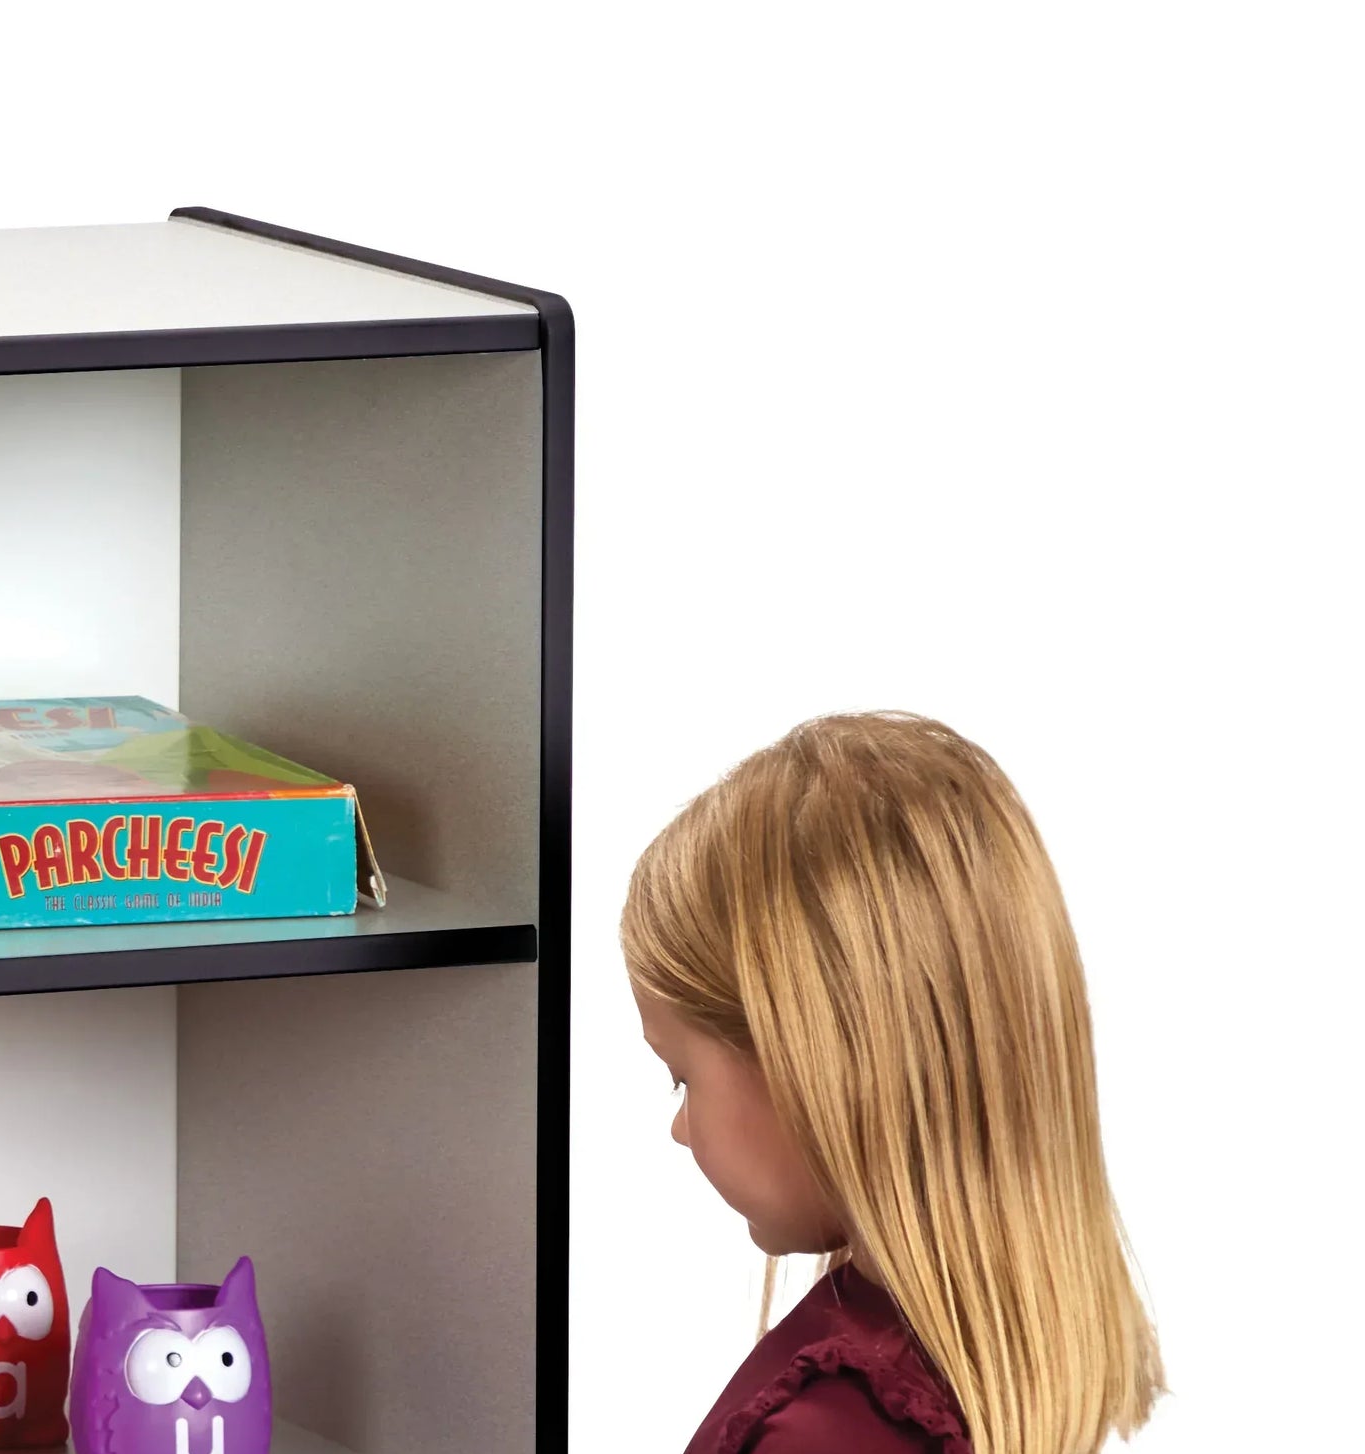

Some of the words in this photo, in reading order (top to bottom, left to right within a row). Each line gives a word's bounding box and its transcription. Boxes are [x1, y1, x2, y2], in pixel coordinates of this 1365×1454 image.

[45, 895, 67, 911] THE
[74, 894, 118, 910] CLASSIC
[124, 893, 160, 909] GAME
[167, 893, 182, 908] OF
[188, 891, 223, 908] INDIA
